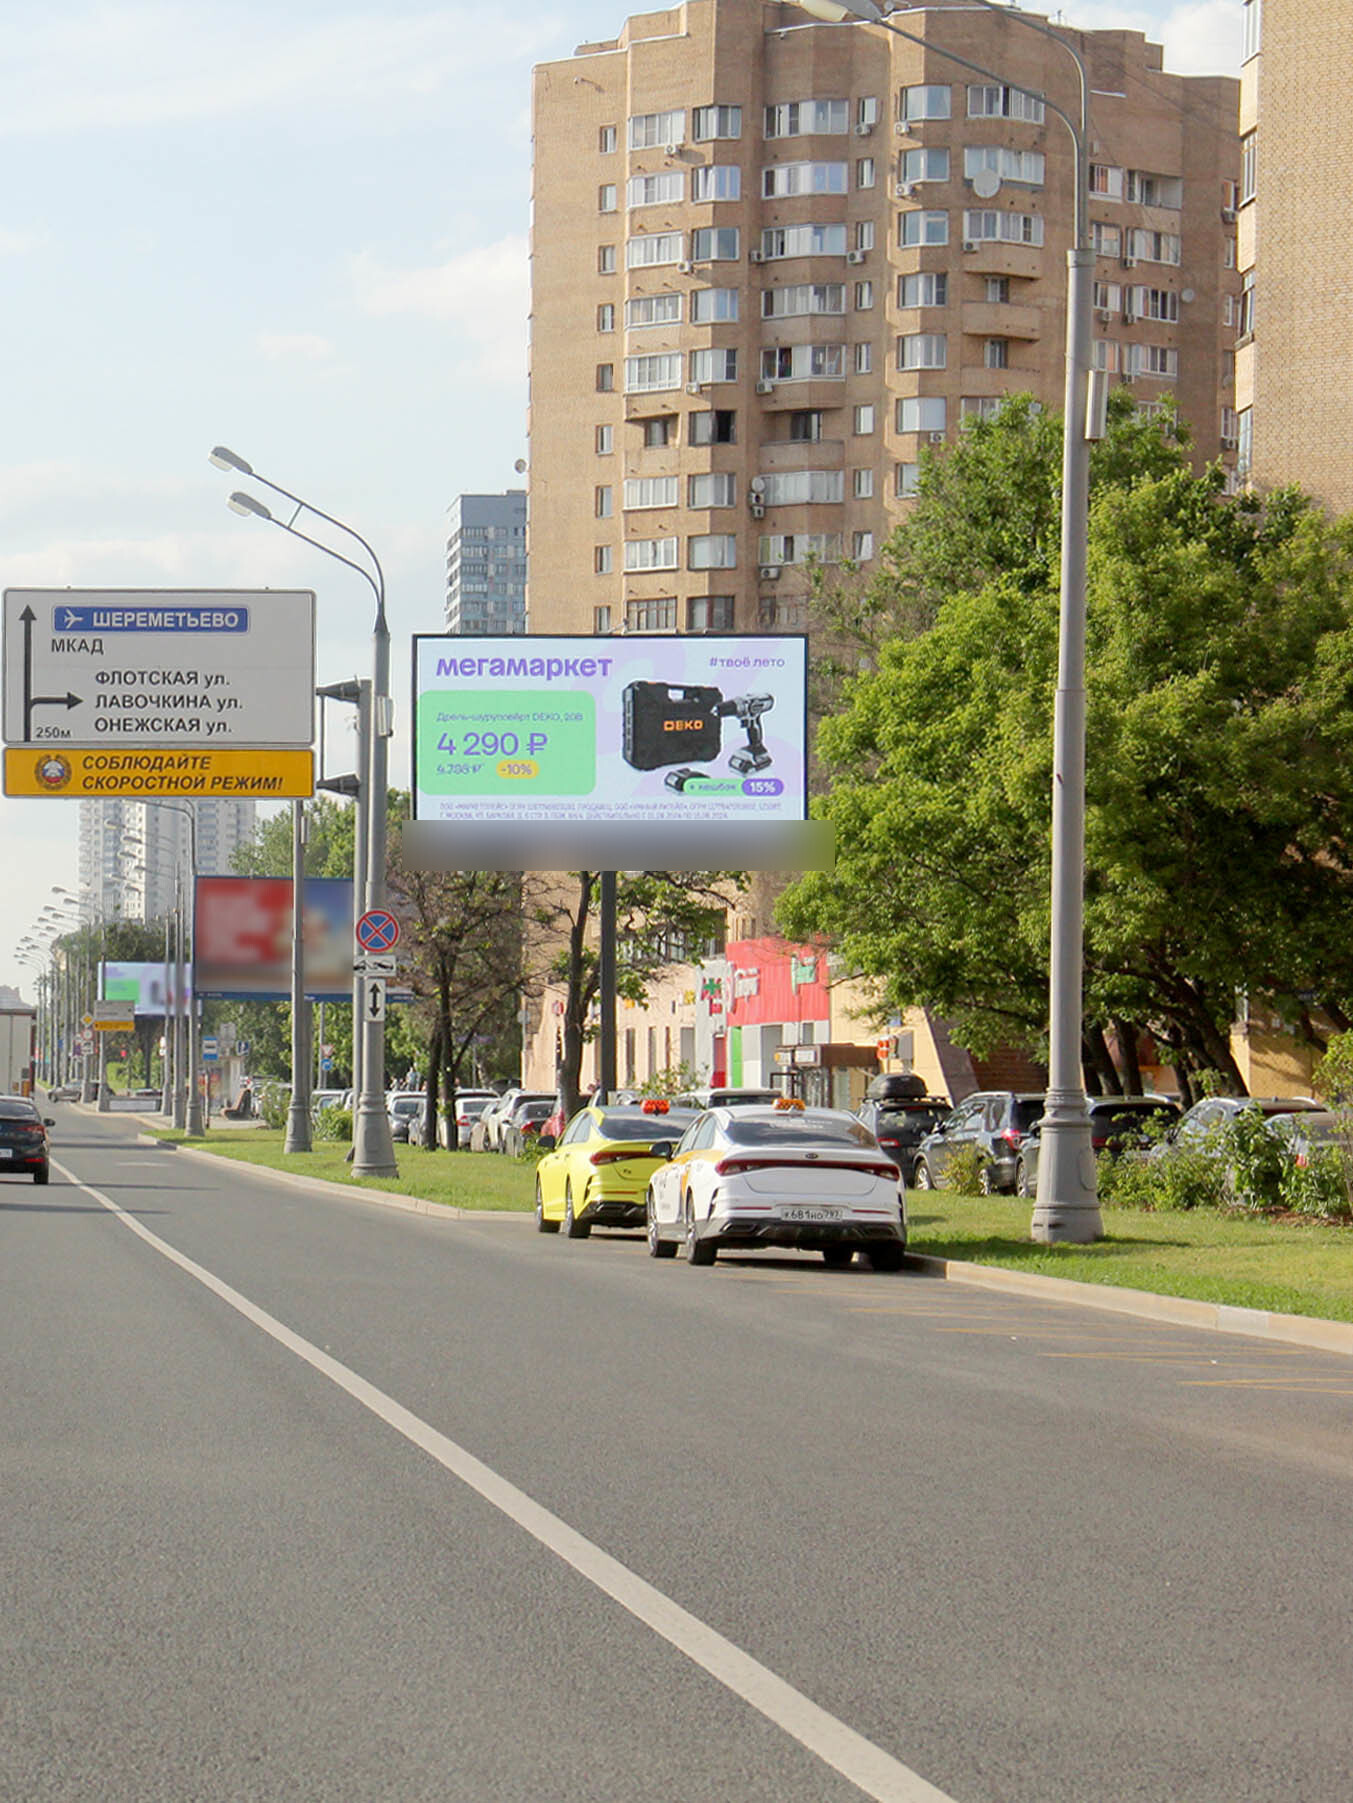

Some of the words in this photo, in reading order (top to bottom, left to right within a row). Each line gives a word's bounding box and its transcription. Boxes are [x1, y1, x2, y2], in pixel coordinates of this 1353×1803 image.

[93, 612, 239, 628] ШЕРЕМЕТЬЕВО
[51, 638, 104, 655] МКАД
[436, 657, 614, 681] мегамаркет
[95, 670, 199, 686] ФЛОТСКАЯ
[204, 673, 231, 689] ул.
[95, 694, 212, 709] ЛАВОЧКИНА
[217, 697, 243, 713] ул.
[36, 727, 71, 739] 250м
[94, 717, 200, 733] ОНЕЖСКАЯ
[206, 720, 232, 736] ул.
[663, 720, 704, 731] DEKO
[463, 731, 520, 756] 290
[82, 753, 212, 772] СОБЛЮДАЙТЕ
[501, 763, 532, 775] -10%
[82, 773, 206, 791] СКОРОСТНОЙ
[210, 776, 283, 790] РЕЖИМ!
[749, 781, 777, 793] 15%
